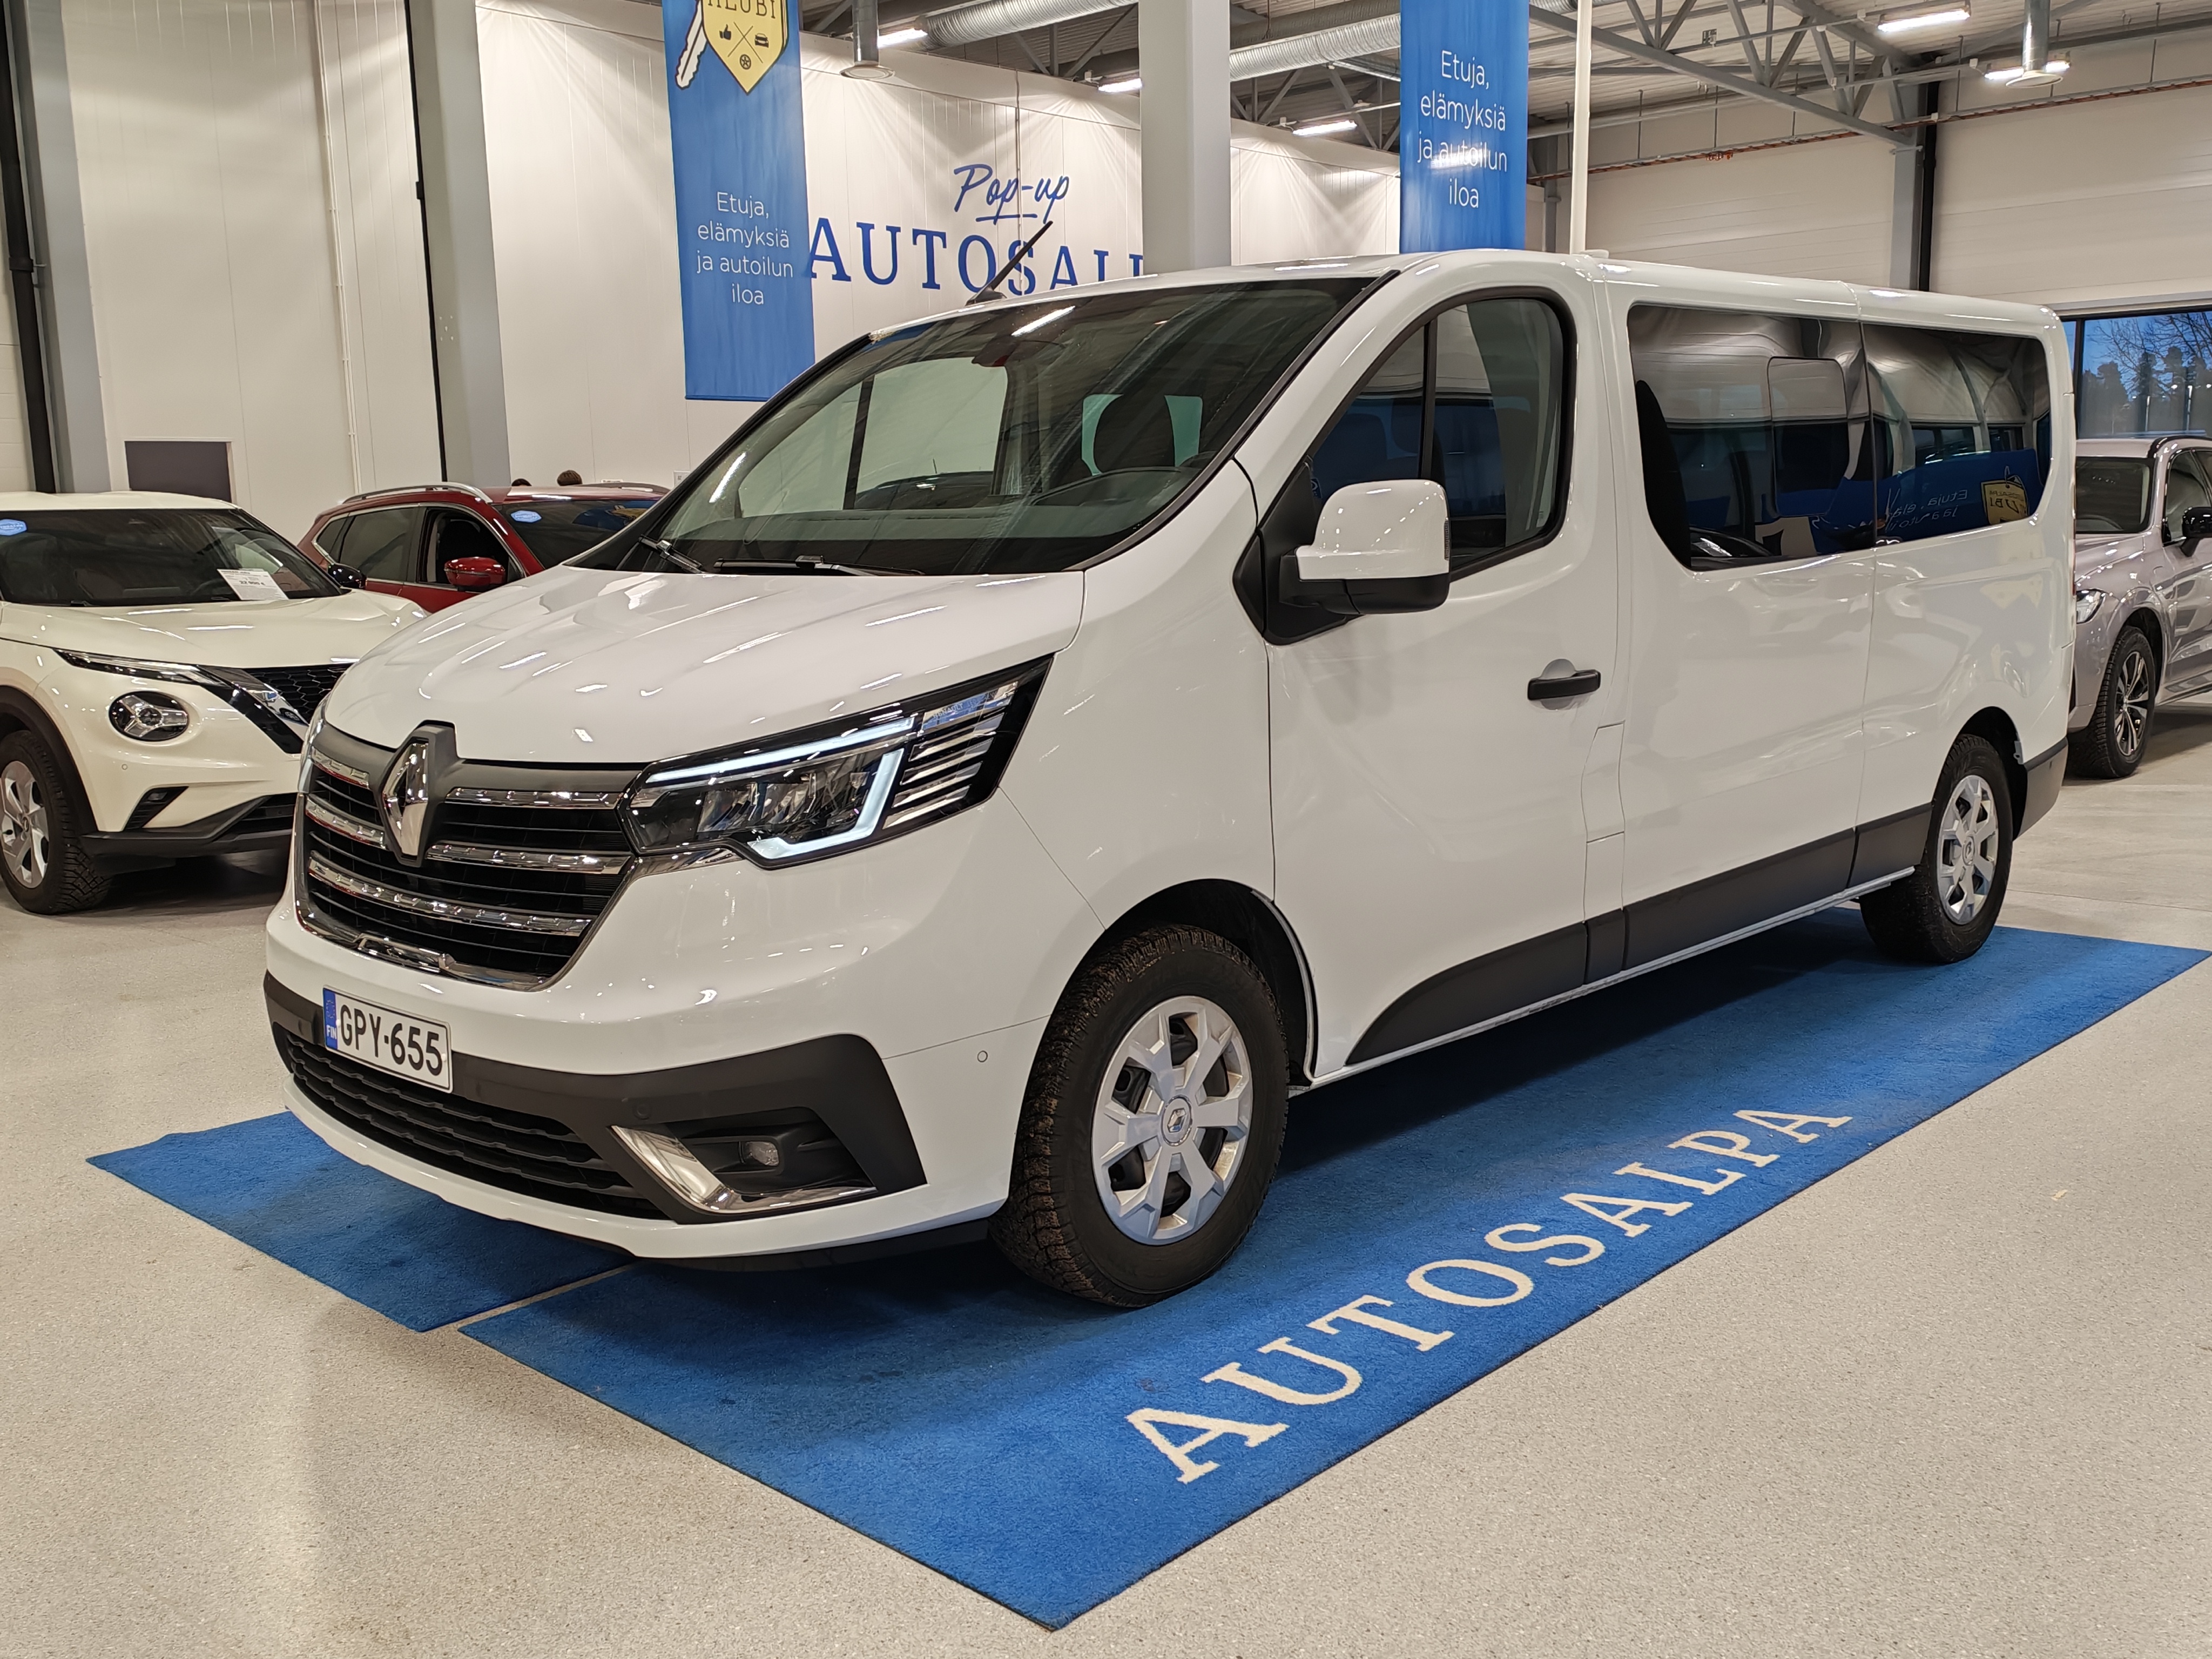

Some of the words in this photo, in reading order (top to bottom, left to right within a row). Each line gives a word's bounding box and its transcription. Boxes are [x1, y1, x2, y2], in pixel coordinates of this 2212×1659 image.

[1441, 50, 1489, 90] Etuja,
[1420, 89, 1506, 131] elämyksiä
[1417, 130, 1432, 163] ja
[1439, 139, 1507, 172] autoilun
[717, 191, 769, 219] Etuja,
[953, 164, 1069, 225] Pop-up
[1449, 178, 1479, 208] iloa
[698, 220, 790, 248] elämyksiä
[697, 250, 713, 274] ja
[720, 255, 793, 278] autoilun
[732, 283, 764, 305] iloa
[326, 1024, 337, 1040] FIN
[340, 1004, 443, 1076] GPY-655
[1125, 1109, 1853, 1485] AUTOSALPA
